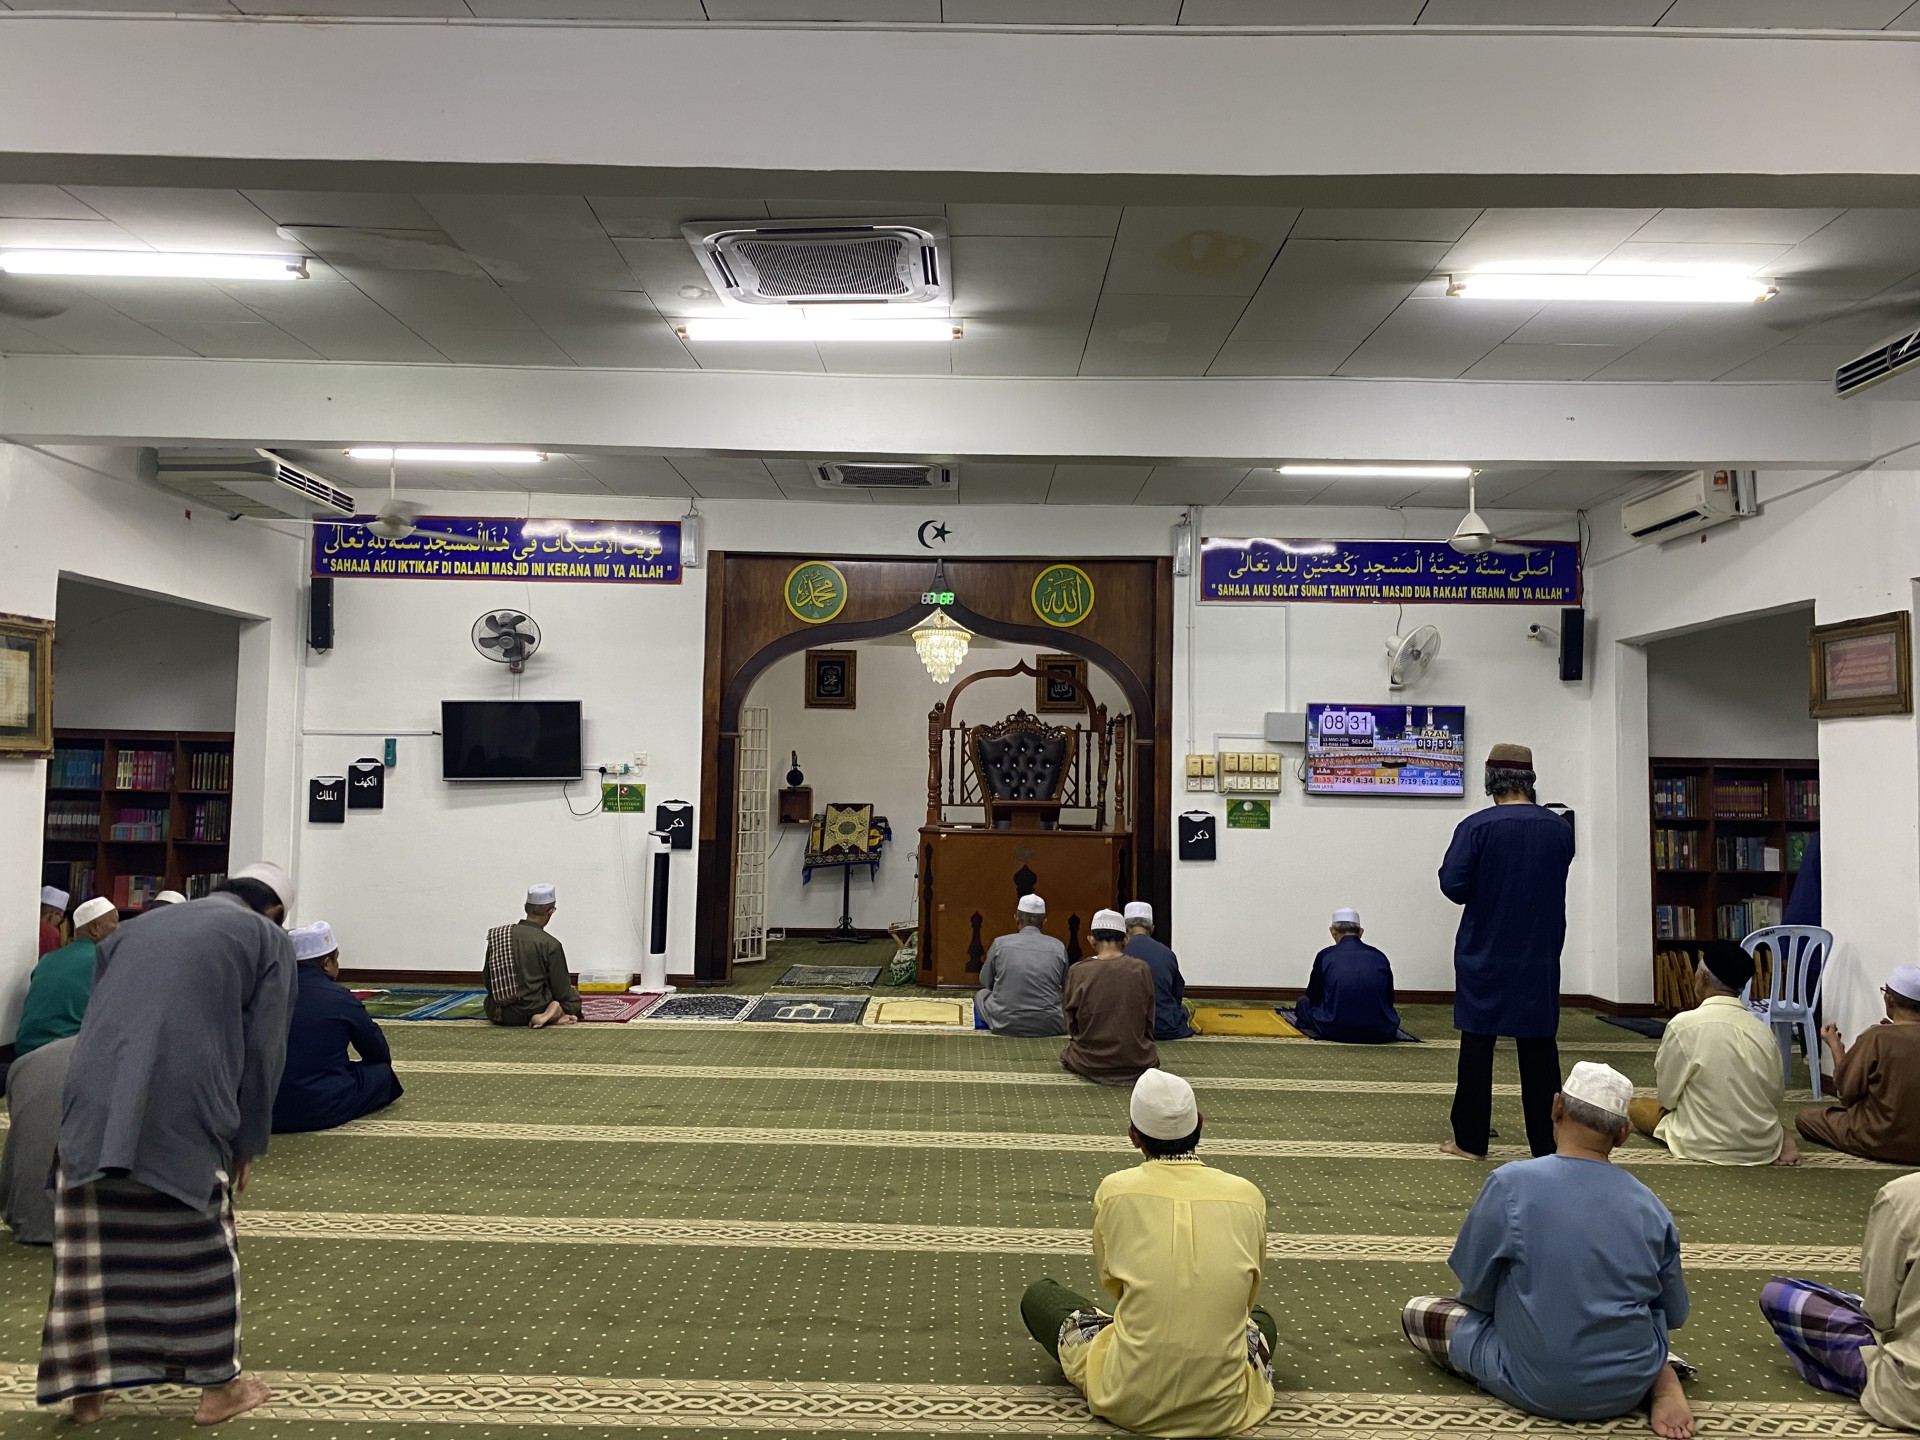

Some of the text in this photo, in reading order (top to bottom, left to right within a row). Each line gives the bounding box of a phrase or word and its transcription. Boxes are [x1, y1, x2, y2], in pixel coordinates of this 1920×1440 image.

[330, 558, 371, 572] SAHAJA
[373, 559, 395, 573] AKU
[398, 560, 439, 574] IKTIKAF
[442, 561, 452, 574] DI
[453, 561, 490, 575] DALAM
[491, 562, 529, 576] MASJID
[531, 563, 545, 576] INI
[547, 563, 591, 577] KERANA
[594, 564, 610, 578] MU
[612, 564, 626, 578] YA
[628, 565, 664, 579] ALLAH
[1217, 584, 1250, 597] SAHAJA
[1252, 584, 1270, 597] AKU
[1272, 584, 1298, 597] SOLAT
[1300, 584, 1328, 597] SUNAT
[1330, 584, 1380, 597] TAHIYYATUL
[1382, 585, 1412, 598] MASJID
[1414, 585, 1431, 598] DUA
[1433, 586, 1468, 599] RAKAAT
[1470, 586, 1505, 599] KERANA
[1507, 587, 1519, 599] MU
[1522, 587, 1533, 599] YA
[1535, 587, 1563, 600] ALLAH
[1324, 714, 1368, 730] 08 31
[1423, 730, 1447, 738] AZAN
